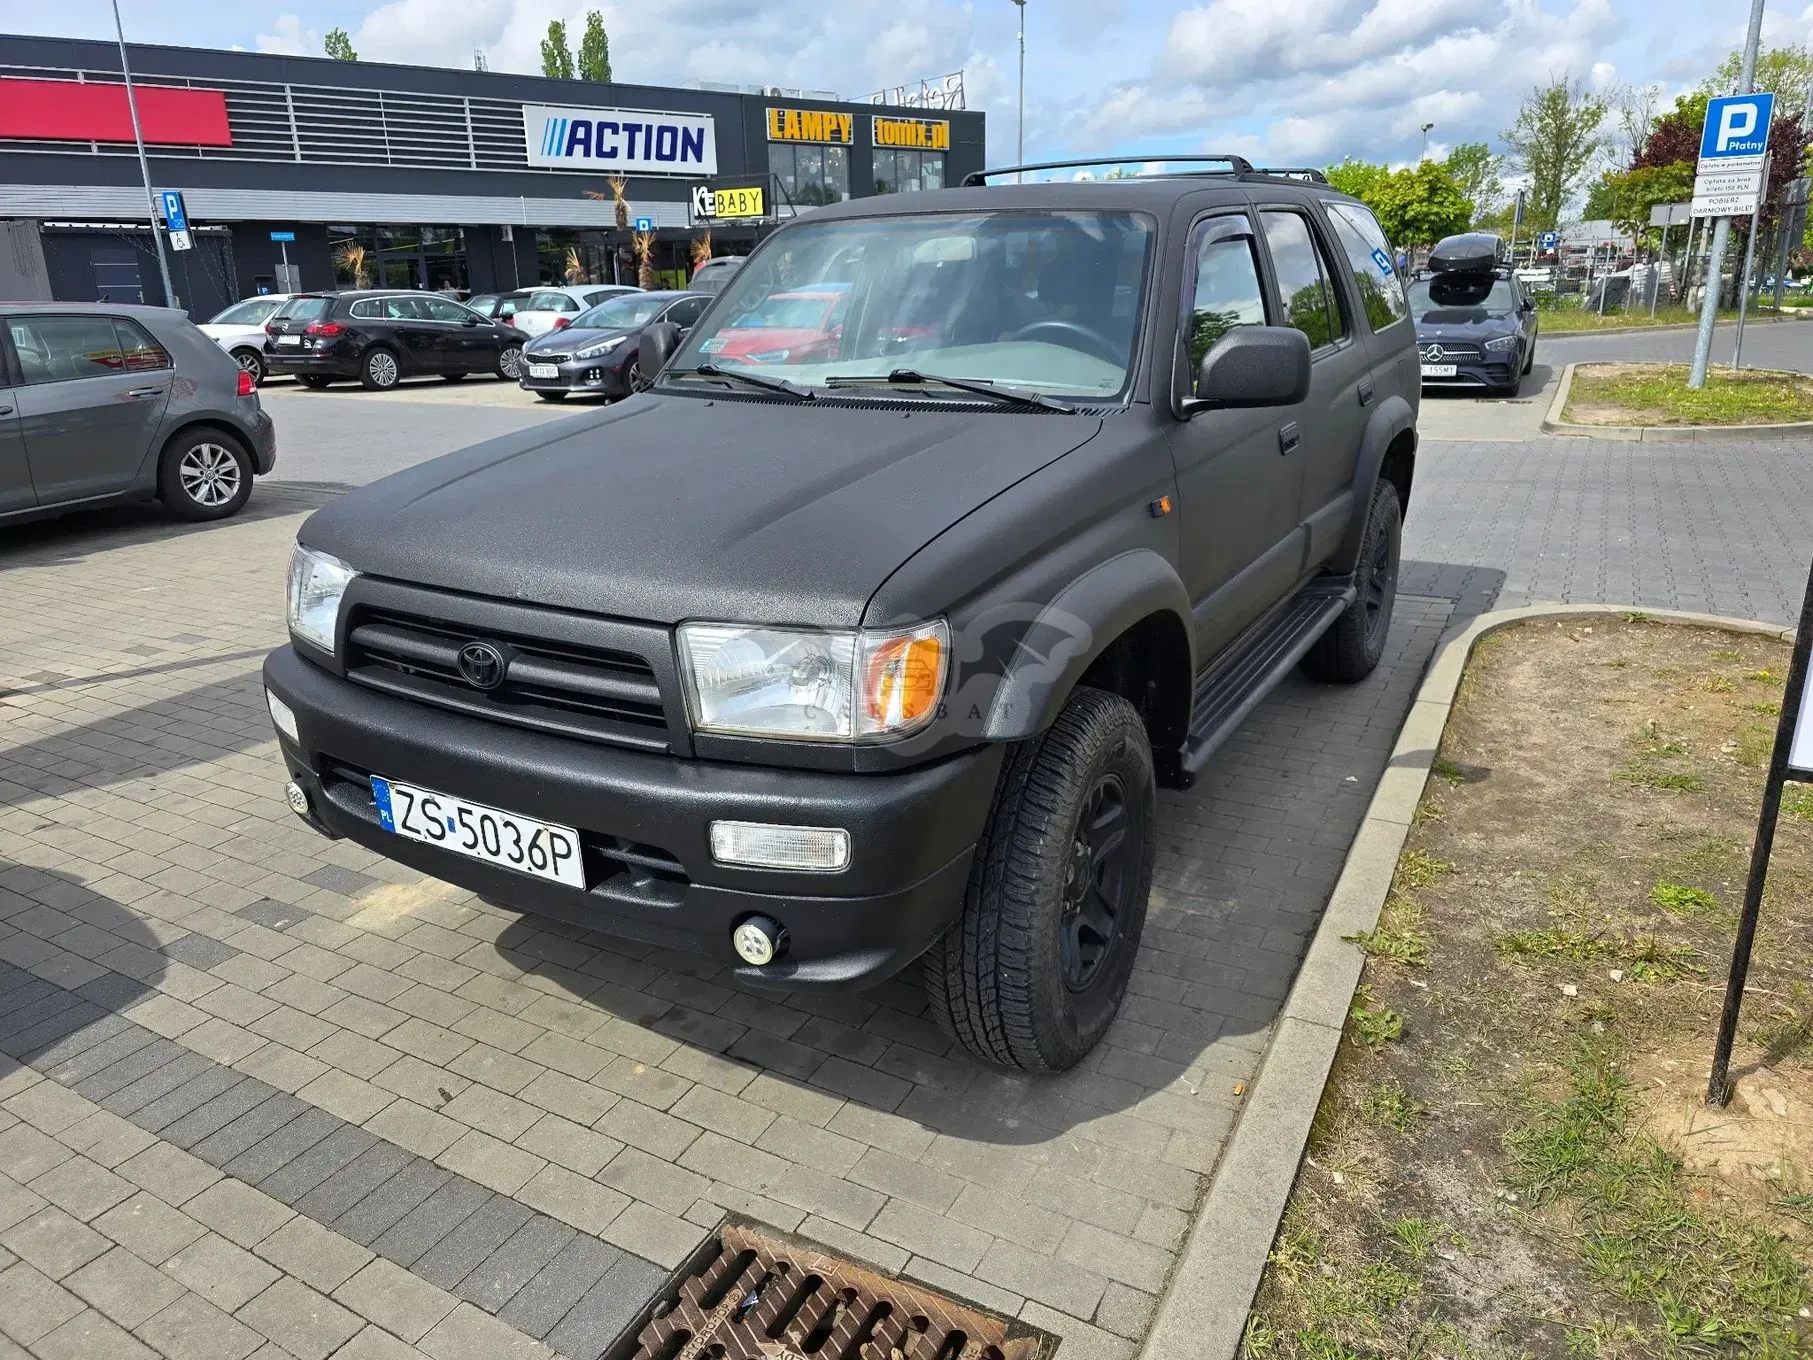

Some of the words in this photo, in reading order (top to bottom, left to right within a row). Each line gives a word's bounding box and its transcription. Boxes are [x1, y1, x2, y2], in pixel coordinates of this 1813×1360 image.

[769, 108, 853, 143] LAMPY
[875, 117, 948, 149] tomix.pl
[1716, 103, 1758, 152] P
[565, 119, 705, 163] ACTION
[1728, 141, 1764, 151] Płatny
[166, 195, 178, 219] P
[1692, 206, 1732, 214] DARMOWY
[1708, 197, 1740, 205] POBIERZ
[380, 809, 393, 823] PL
[395, 788, 446, 841] ZS
[457, 806, 573, 876] 5036P
